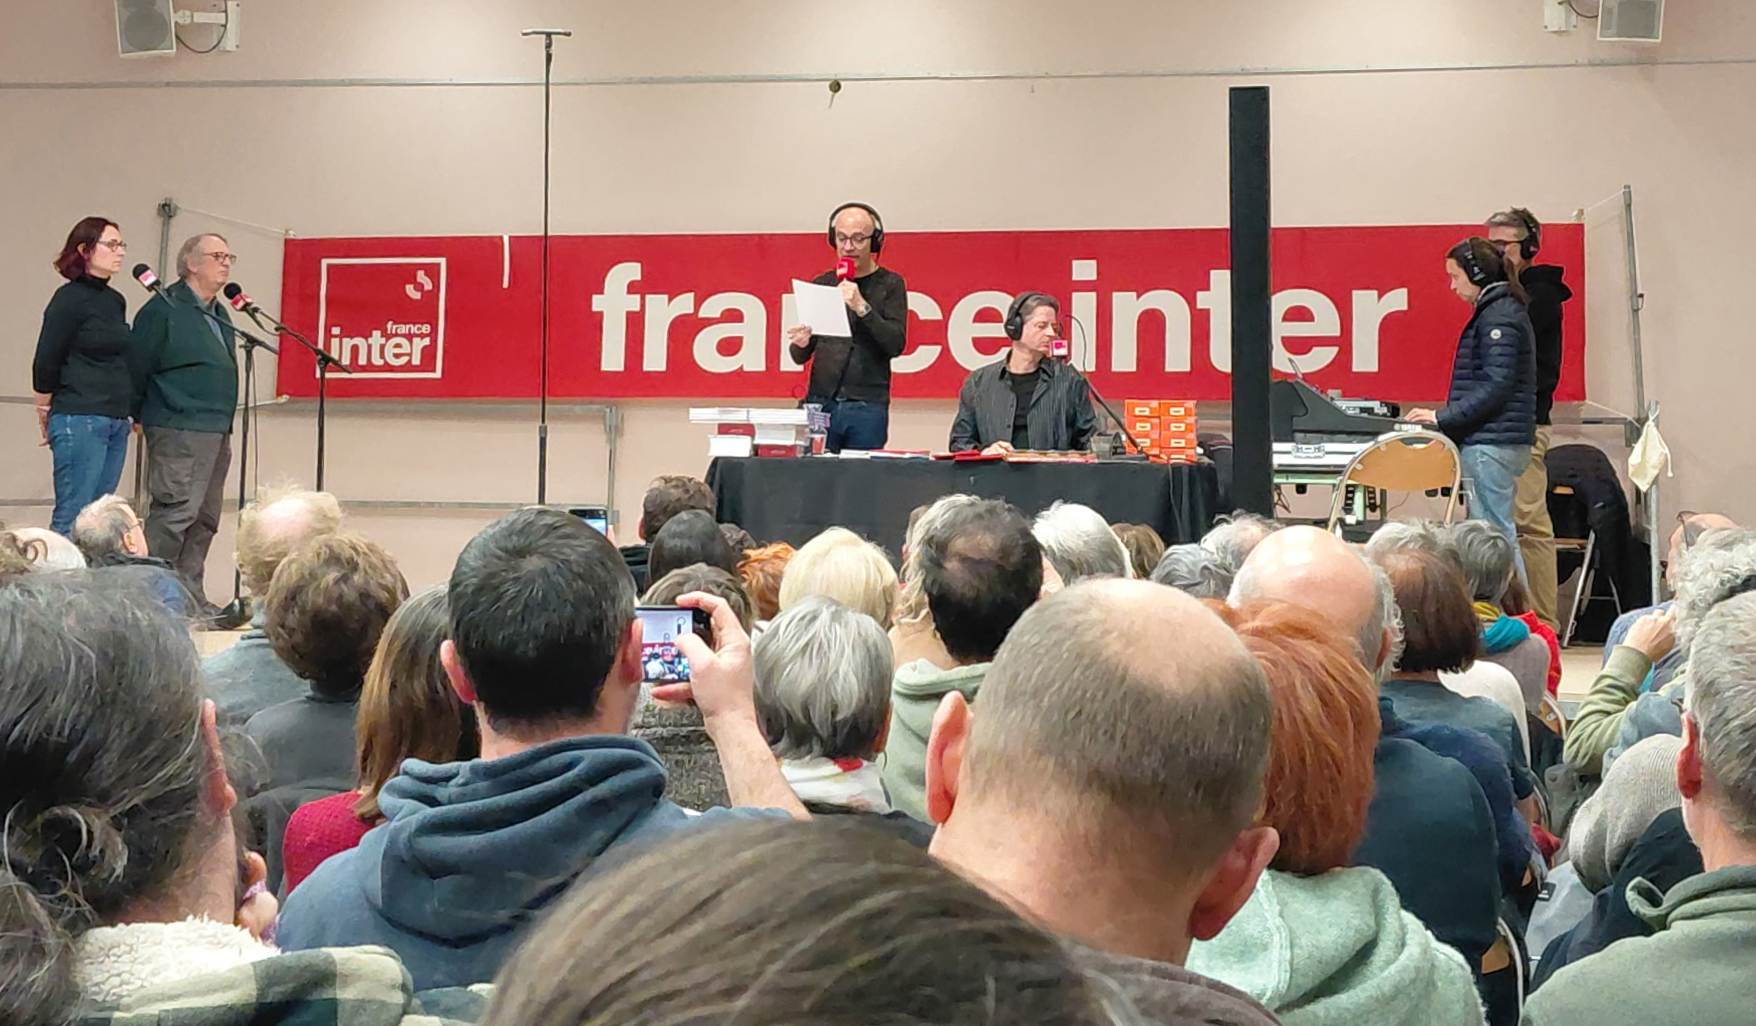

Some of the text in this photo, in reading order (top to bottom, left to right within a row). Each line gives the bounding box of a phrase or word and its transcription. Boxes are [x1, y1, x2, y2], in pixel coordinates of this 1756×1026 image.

[386, 320, 431, 335] france
[591, 259, 1408, 374] frace inter
[330, 326, 431, 366] inter
